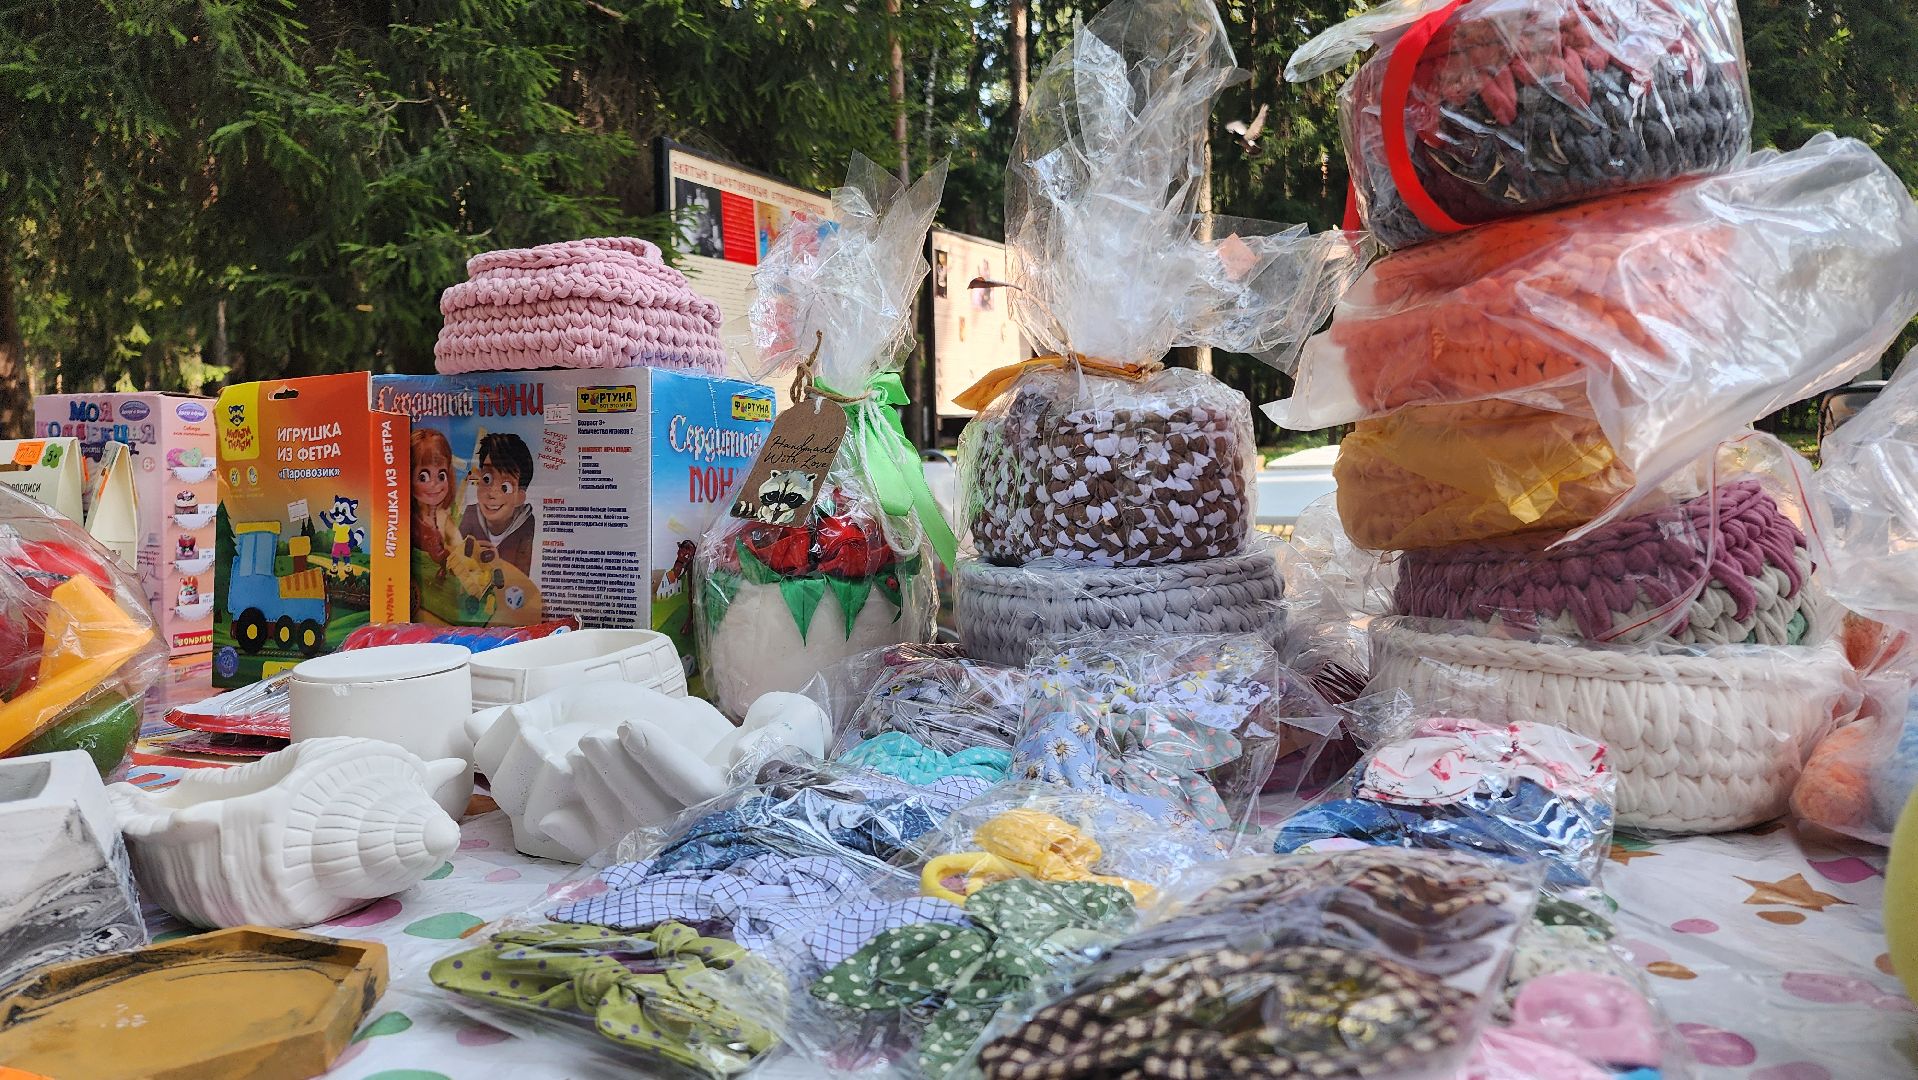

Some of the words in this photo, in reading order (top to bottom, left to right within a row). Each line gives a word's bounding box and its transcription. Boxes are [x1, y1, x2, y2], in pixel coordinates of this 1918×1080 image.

[69, 400, 114, 423] МОЯ
[277, 422, 342, 443] ИГРУШКА
[381, 420, 394, 465] ФЕТРА
[669, 414, 762, 462] Сердитый
[277, 446, 293, 462] ИЗ
[297, 443, 341, 462] ФЕТРА
[771, 434, 839, 456] Handmade
[48, 450, 58, 463] 5+
[143, 458, 156, 471] 6+
[764, 451, 800, 465] With
[800, 456, 828, 470] Love
[278, 466, 341, 481] «Паровозик»
[385, 467, 398, 487] ИЗ
[689, 465, 736, 503] ПОН
[385, 489, 399, 558] ИГРУШКА
[178, 634, 212, 646] BONDIBO
